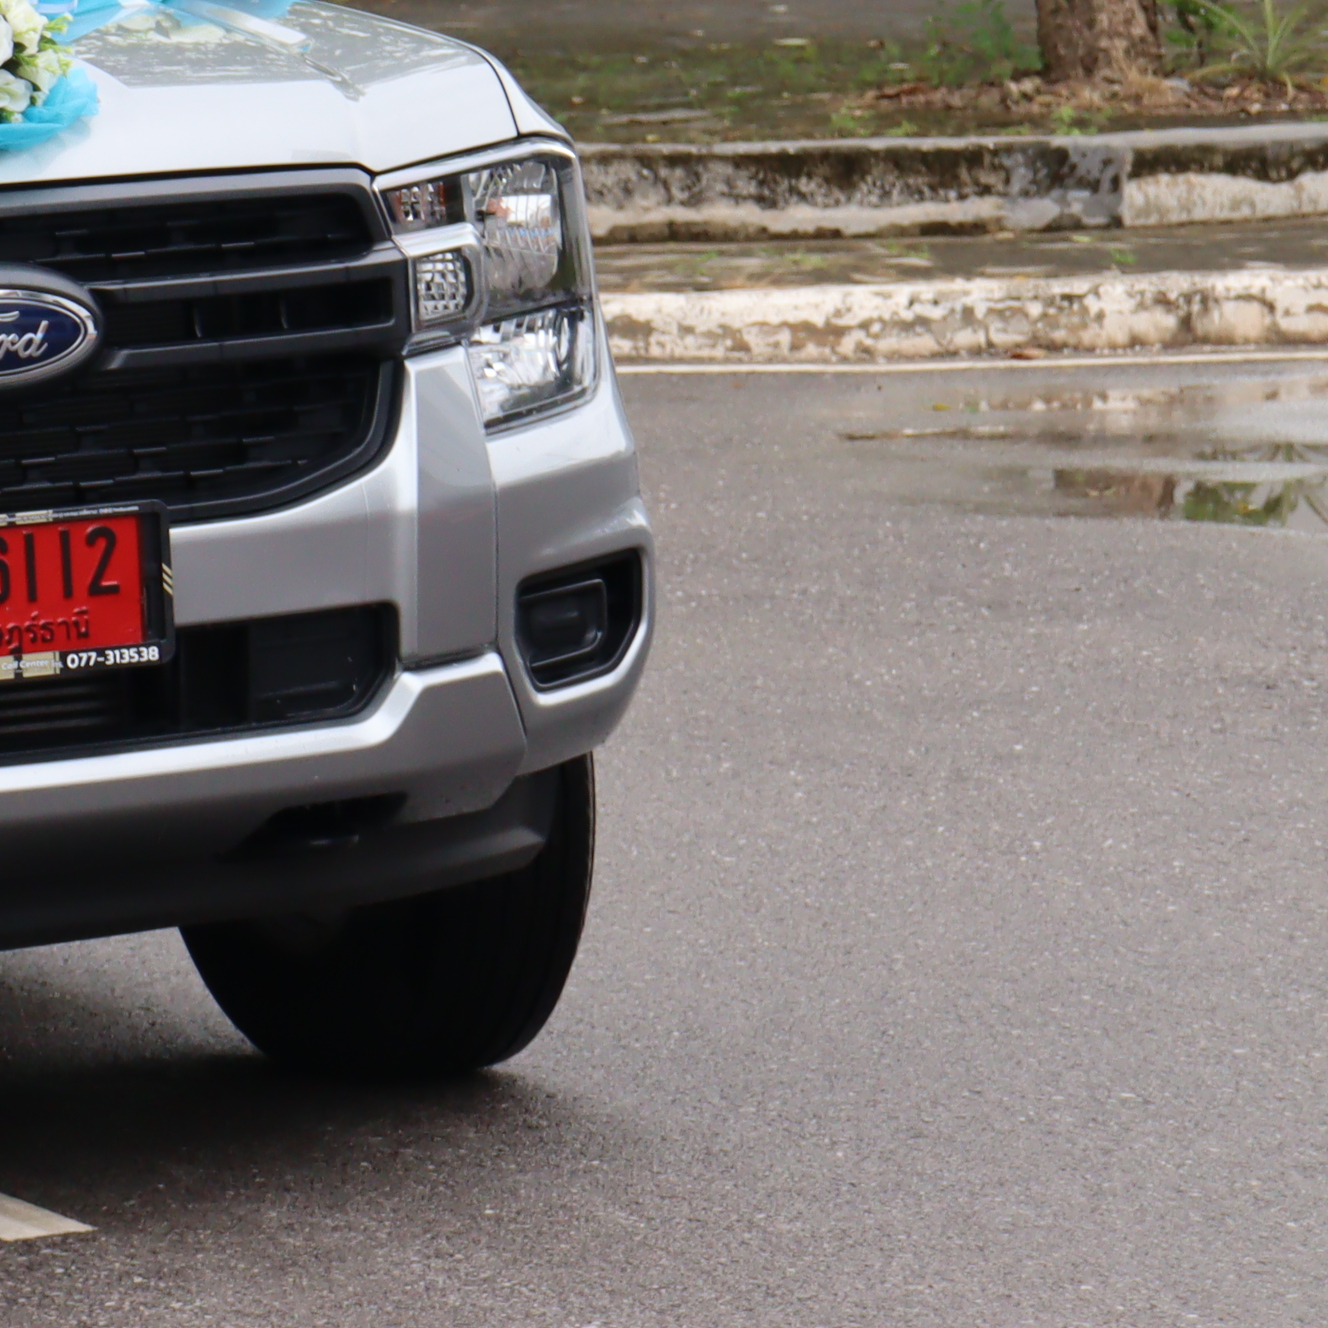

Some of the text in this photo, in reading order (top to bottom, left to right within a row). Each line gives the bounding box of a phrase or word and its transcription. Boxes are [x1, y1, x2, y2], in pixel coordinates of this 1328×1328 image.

[1, 660, 19, 670] Call
[19, 659, 50, 669] Center
[66, 646, 160, 670] 077-313538
